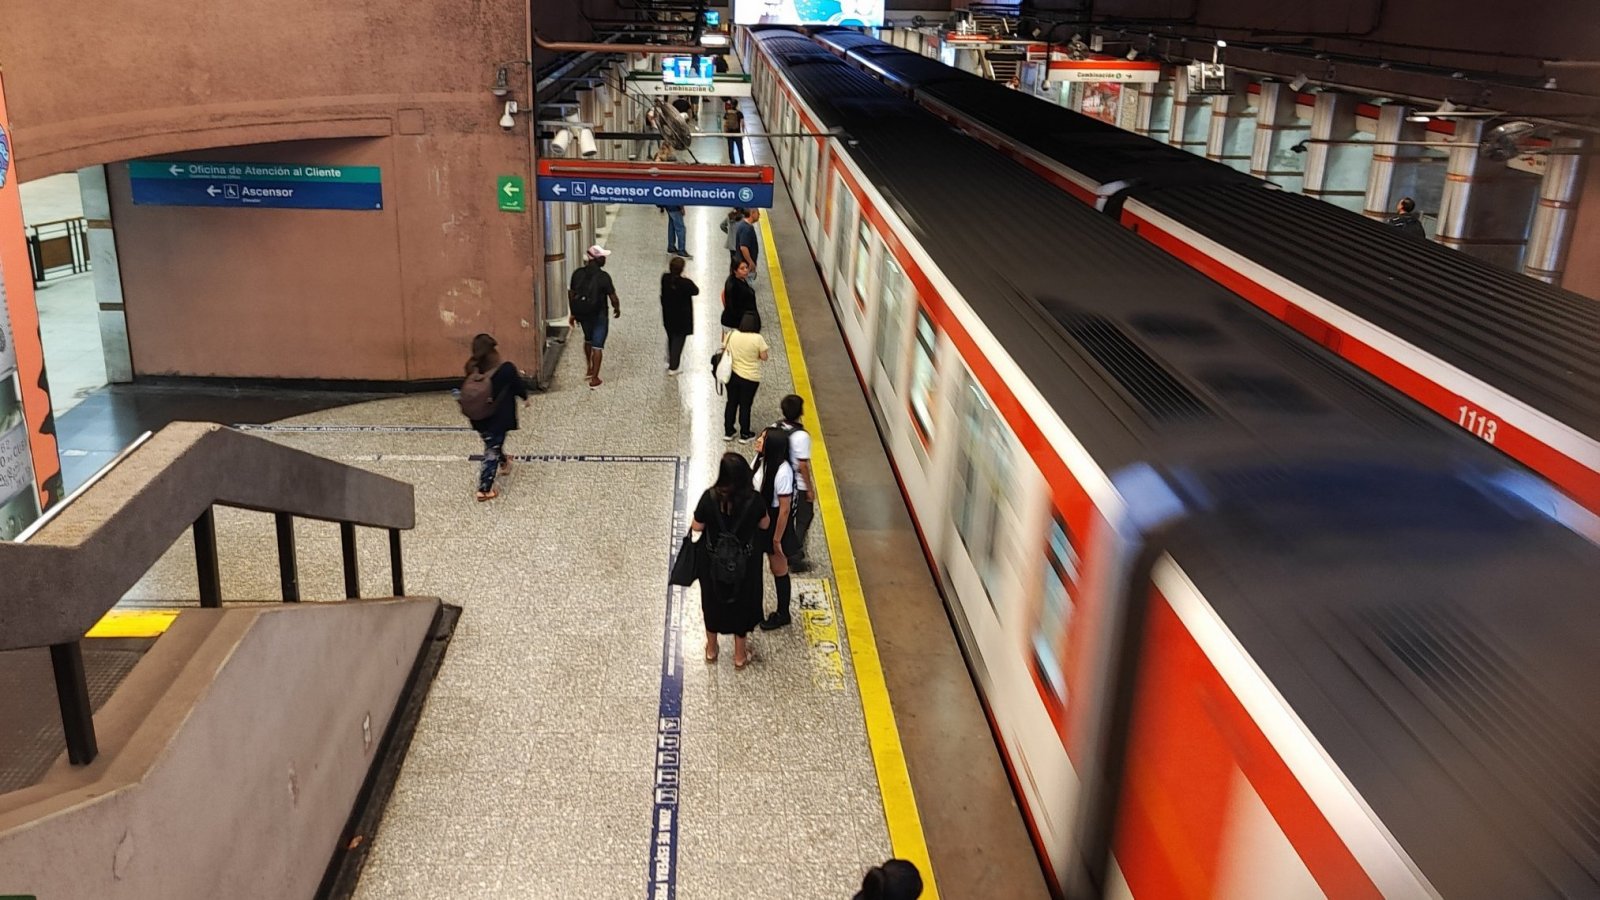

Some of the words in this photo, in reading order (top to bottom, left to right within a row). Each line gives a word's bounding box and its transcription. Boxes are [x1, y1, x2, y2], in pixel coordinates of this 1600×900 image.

[189, 164, 226, 175] Oficina
[229, 165, 242, 175] de
[245, 165, 290, 176] Atención
[293, 167, 303, 176] al
[305, 167, 342, 178] Cliente
[241, 186, 294, 197] Ascensor
[590, 184, 650, 196] Ascensor
[653, 186, 735, 199] Combinación
[1459, 406, 1497, 444] 1113
[658, 809, 672, 831] ZONA
[655, 846, 670, 881] ESPERA
